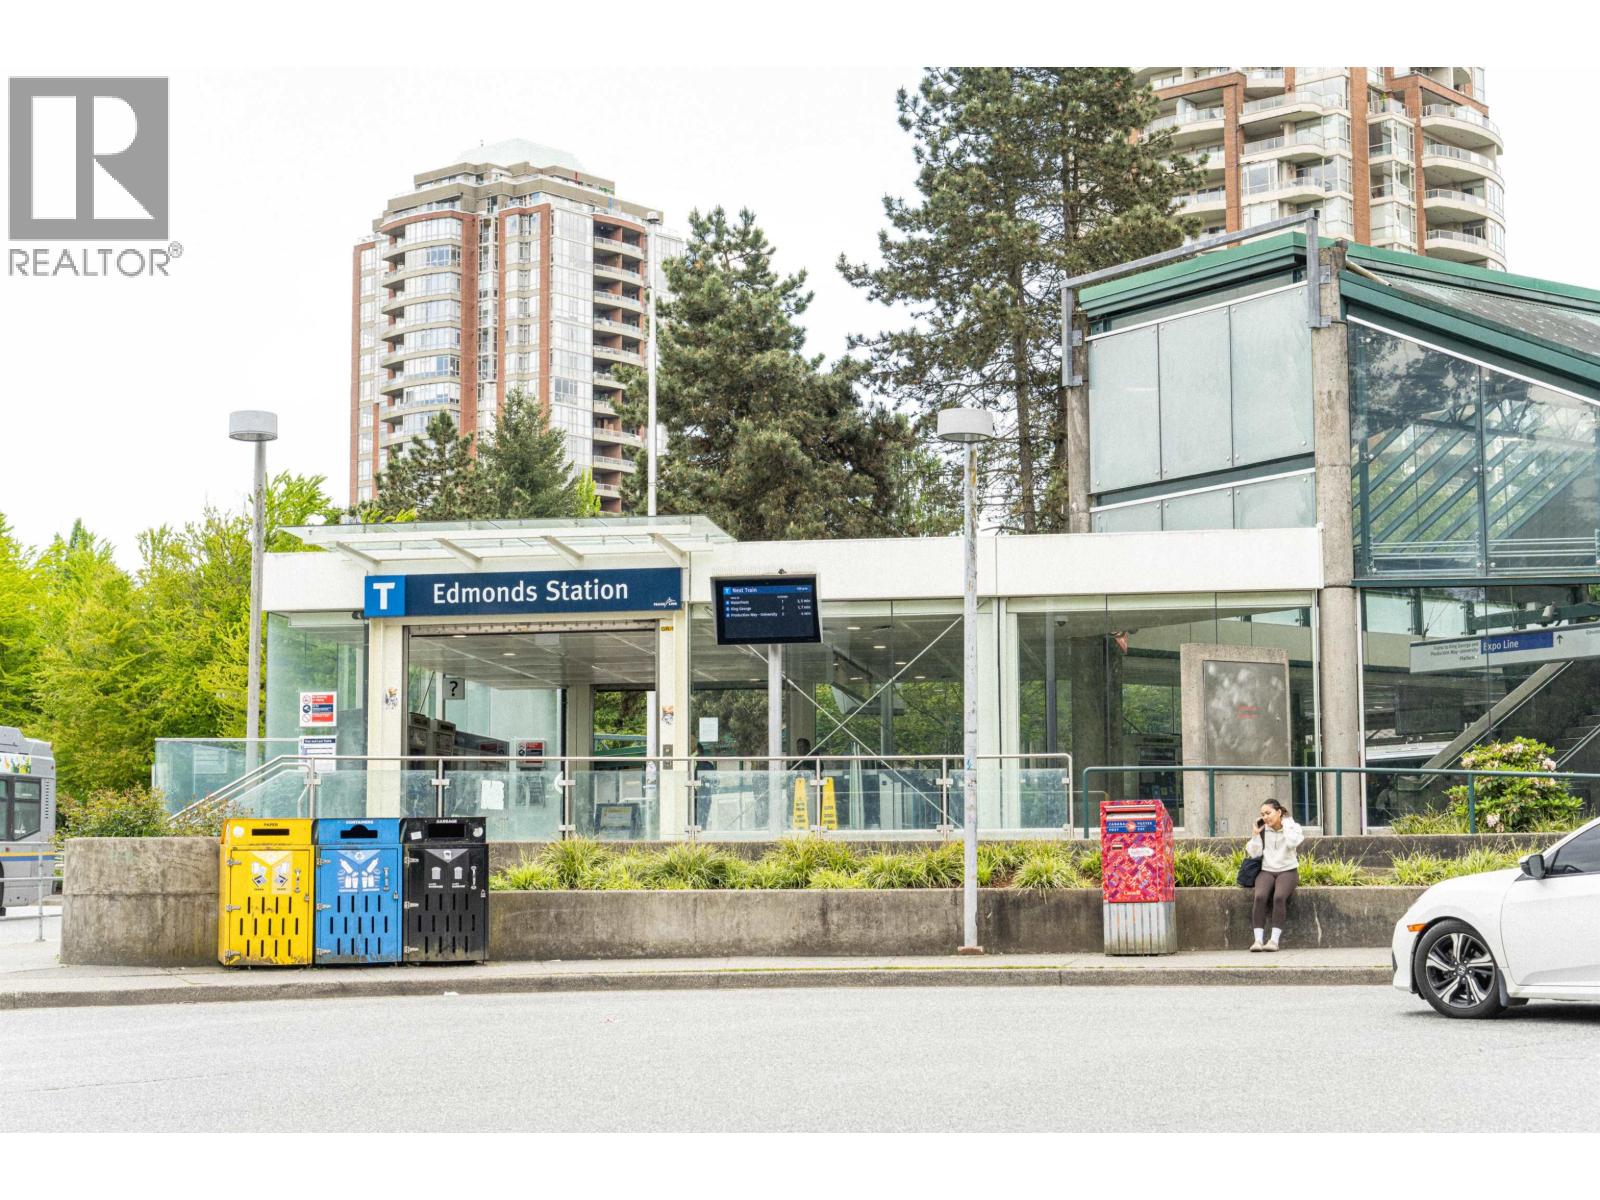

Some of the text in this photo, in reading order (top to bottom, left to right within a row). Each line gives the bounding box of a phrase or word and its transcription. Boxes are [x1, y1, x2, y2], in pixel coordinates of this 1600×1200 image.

[372, 578, 629, 610] T Edmonds Station
[1483, 640, 1519, 652] Expo Line
